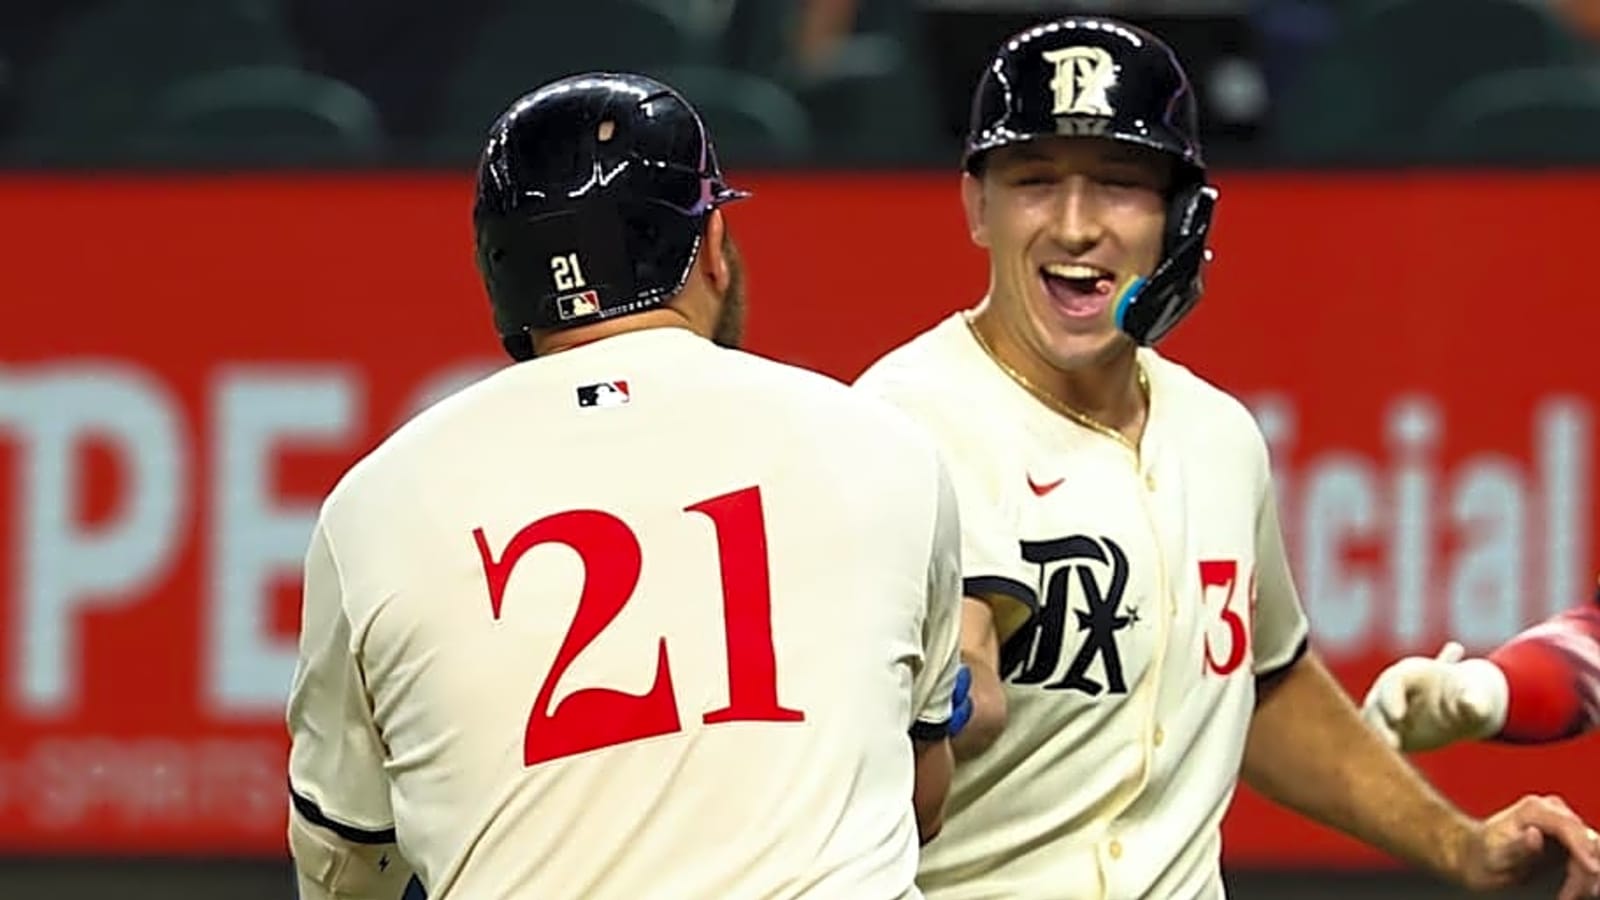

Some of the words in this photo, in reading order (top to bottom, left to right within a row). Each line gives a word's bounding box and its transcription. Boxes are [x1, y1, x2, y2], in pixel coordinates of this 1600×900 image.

[551, 253, 586, 291] 21
[0, 360, 440, 716] PE
[472, 484, 806, 767] 21
[1198, 560, 1257, 677] 3
